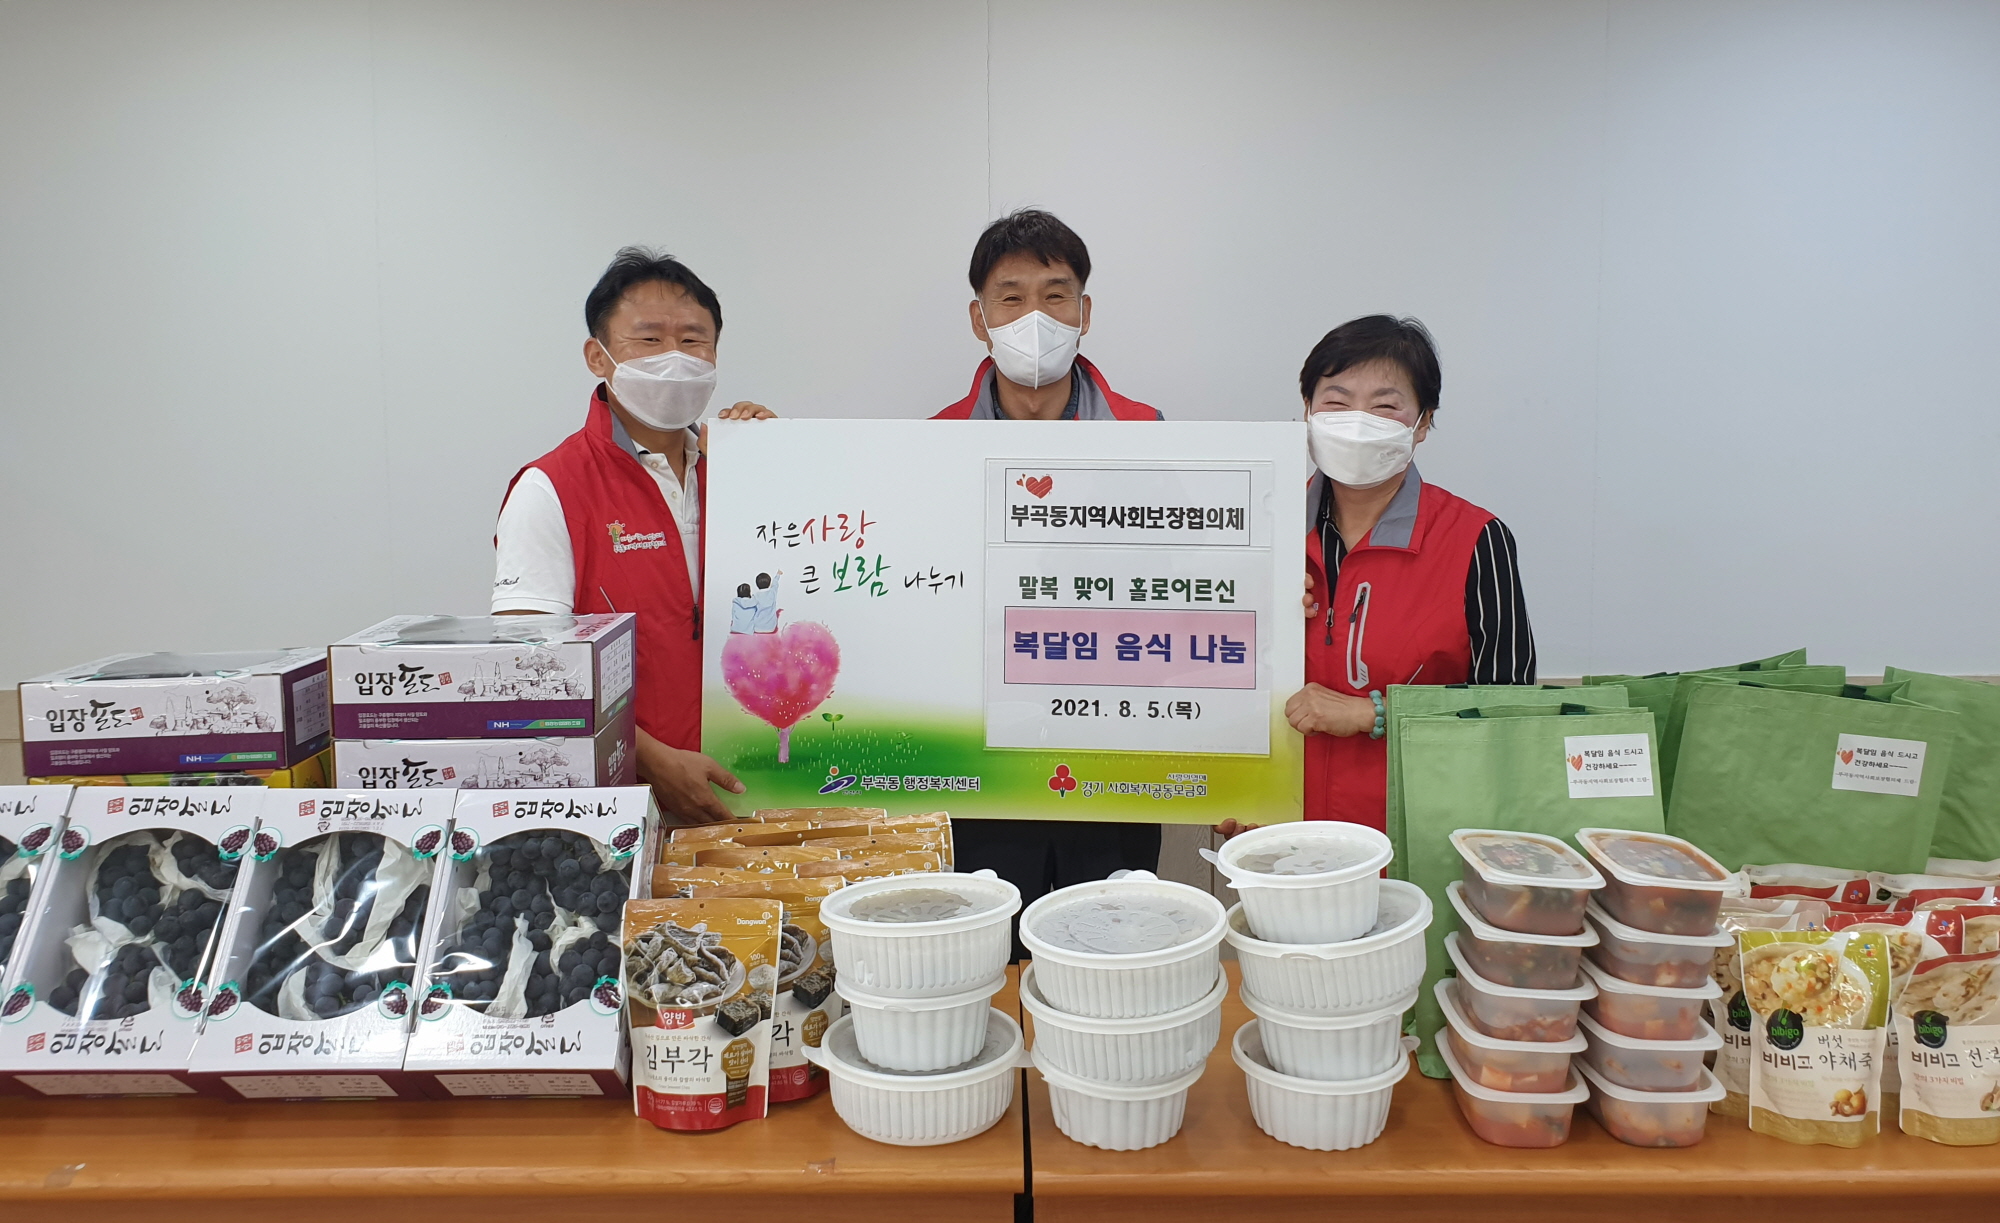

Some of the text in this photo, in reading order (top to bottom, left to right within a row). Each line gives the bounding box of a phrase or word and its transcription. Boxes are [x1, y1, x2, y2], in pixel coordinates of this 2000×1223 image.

[1010, 504, 1245, 531] 부곡동지역사회보장협의체
[799, 553, 964, 597] 큰 보람 나누기
[1018, 575, 1236, 604] 말복 맞이 홀로어르신
[1013, 631, 1247, 664] 복달임 음식 나눔
[1051, 698, 1109, 718] 2021.
[1118, 700, 1138, 719] 8.
[186, 755, 202, 763] NH
[1607, 749, 1621, 757] 음식
[861, 775, 981, 793] 부곡동 행정복지센터
[1081, 781, 1208, 800] 경기 사회복지공동모금회
[736, 917, 767, 927] Dongwon
[663, 1012, 686, 1025] 양반
[1771, 1026, 1800, 1039] bibigo
[1918, 1024, 1944, 1037] bibigo
[1818, 1034, 1844, 1050] 버섯
[646, 1044, 714, 1074] 김부각
[1762, 1051, 1873, 1072] 비비고 야채죽
[1911, 1051, 1960, 1069] 비비고
